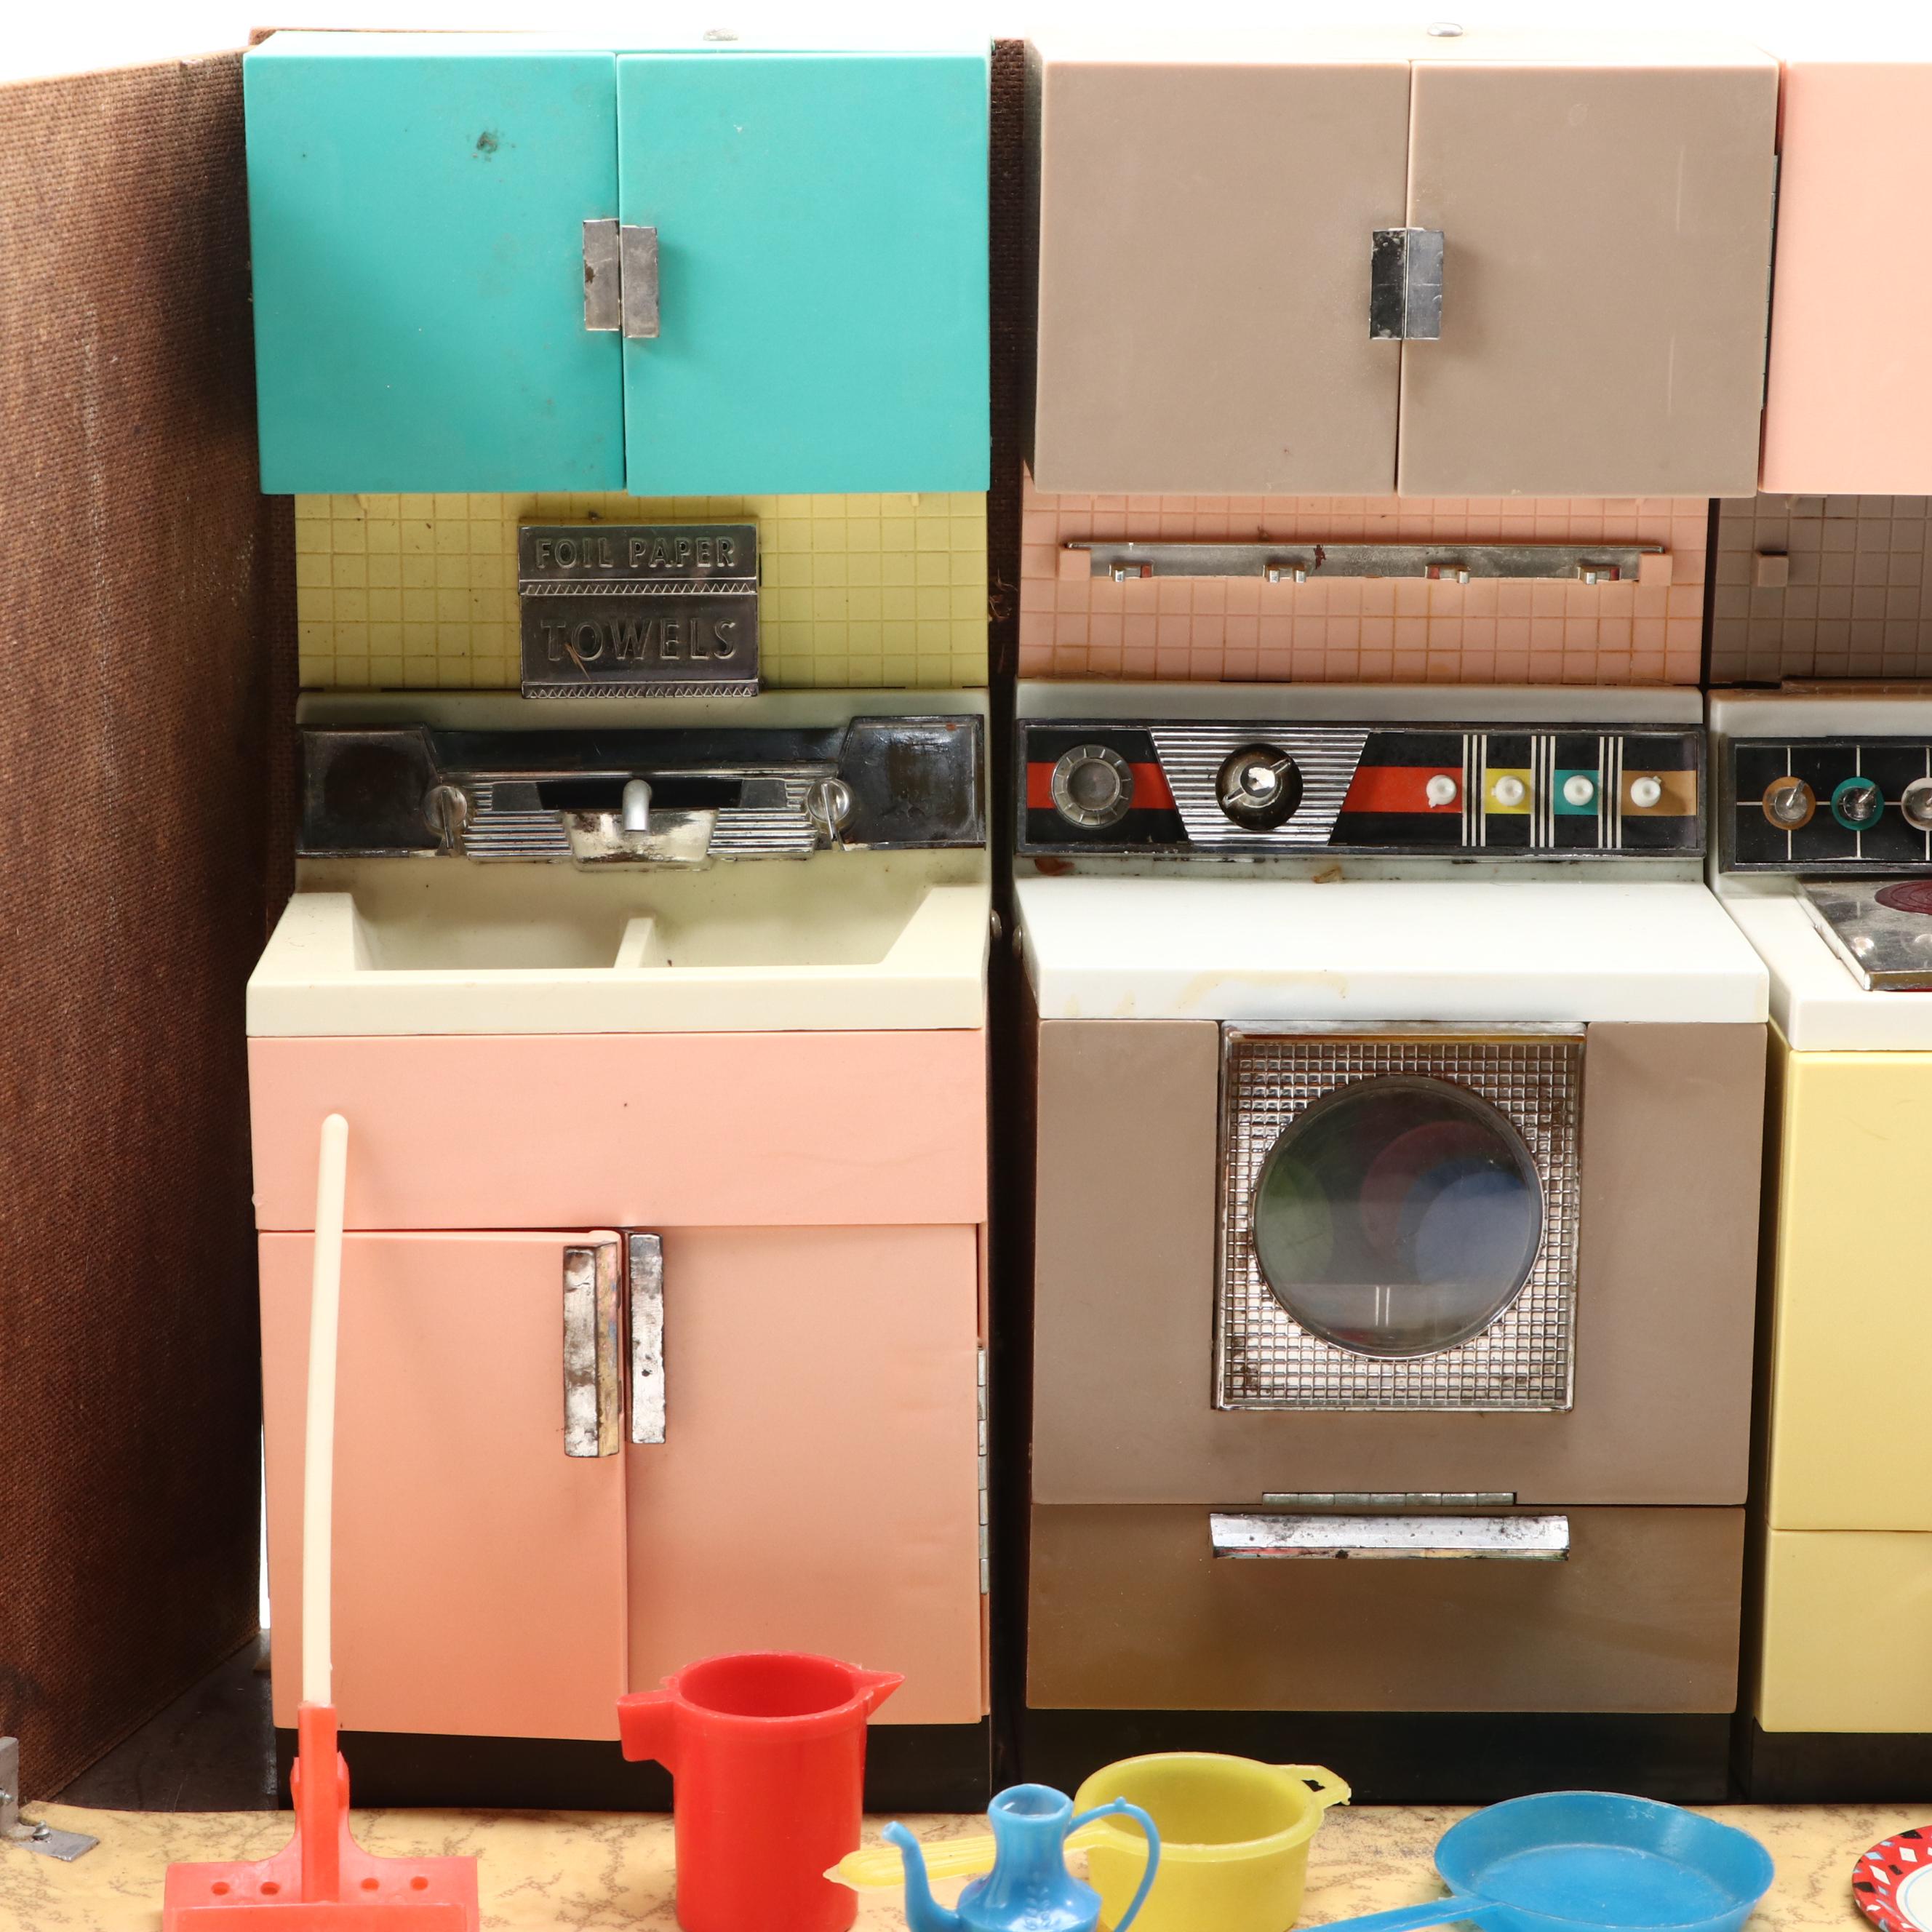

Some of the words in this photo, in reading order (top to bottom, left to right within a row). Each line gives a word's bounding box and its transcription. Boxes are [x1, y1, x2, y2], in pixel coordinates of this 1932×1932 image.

[536, 538, 614, 569] FOIL
[628, 536, 735, 568] PAPER
[540, 619, 737, 662] TOWELS
